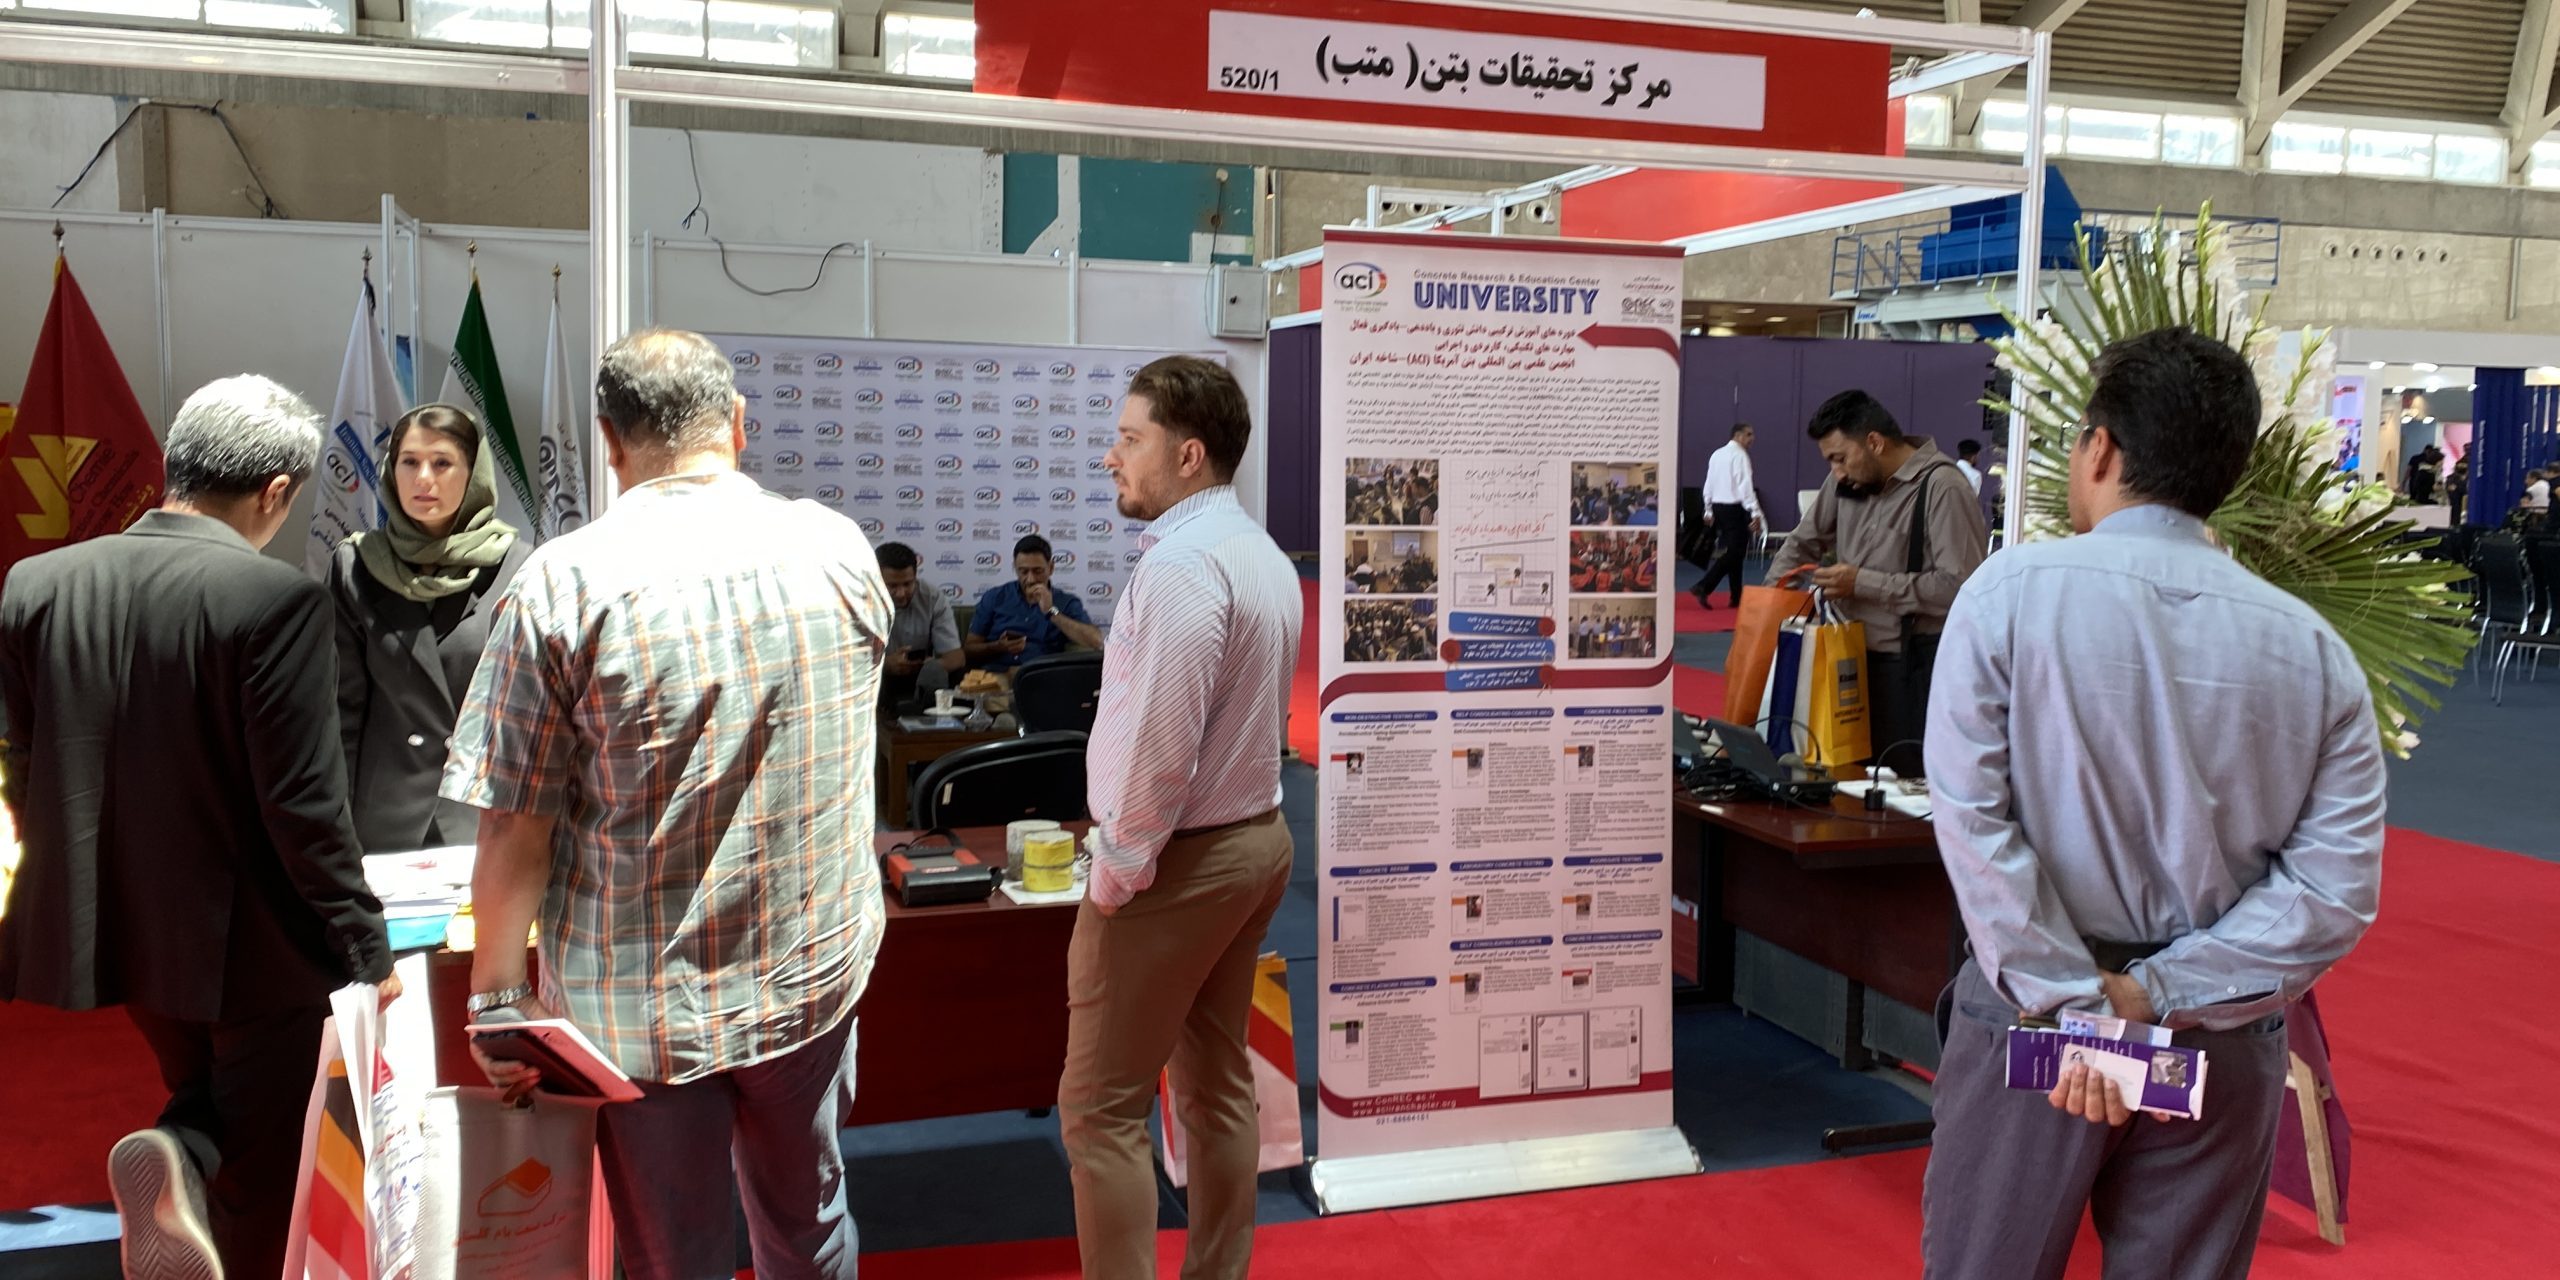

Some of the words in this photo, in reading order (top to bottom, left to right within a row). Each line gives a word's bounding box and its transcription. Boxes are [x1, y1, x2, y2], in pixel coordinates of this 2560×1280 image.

[1220, 66, 1281, 92] 520/1
[1479, 51, 1595, 100] تحقیقات
[1600, 62, 1672, 109] مرکز
[1413, 269, 1458, 281] Concrete
[1460, 271, 1505, 283] Research
[1508, 274, 1516, 283] &
[1518, 274, 1566, 286] Education
[1568, 276, 1601, 287] Center
[1413, 281, 1600, 316] UNIVERSITY
